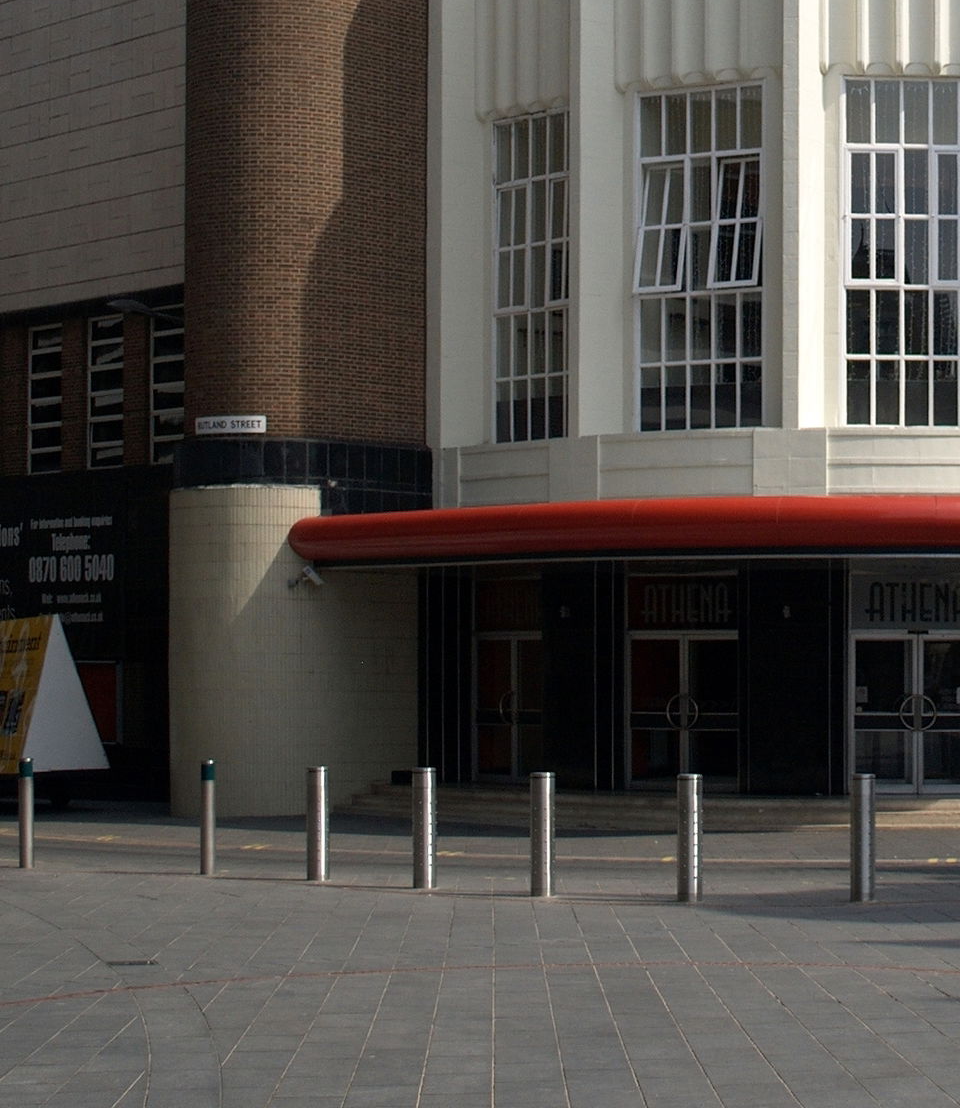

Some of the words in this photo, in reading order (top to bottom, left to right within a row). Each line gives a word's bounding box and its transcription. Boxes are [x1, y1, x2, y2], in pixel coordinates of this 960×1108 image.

[198, 420, 228, 429] RUTLAND
[230, 419, 262, 429] STREET
[51, 533, 91, 553] Telephone:
[29, 556, 57, 583] 0870
[60, 555, 82, 582] 600
[84, 553, 115, 582] 5040
[640, 582, 732, 623] ATHENA
